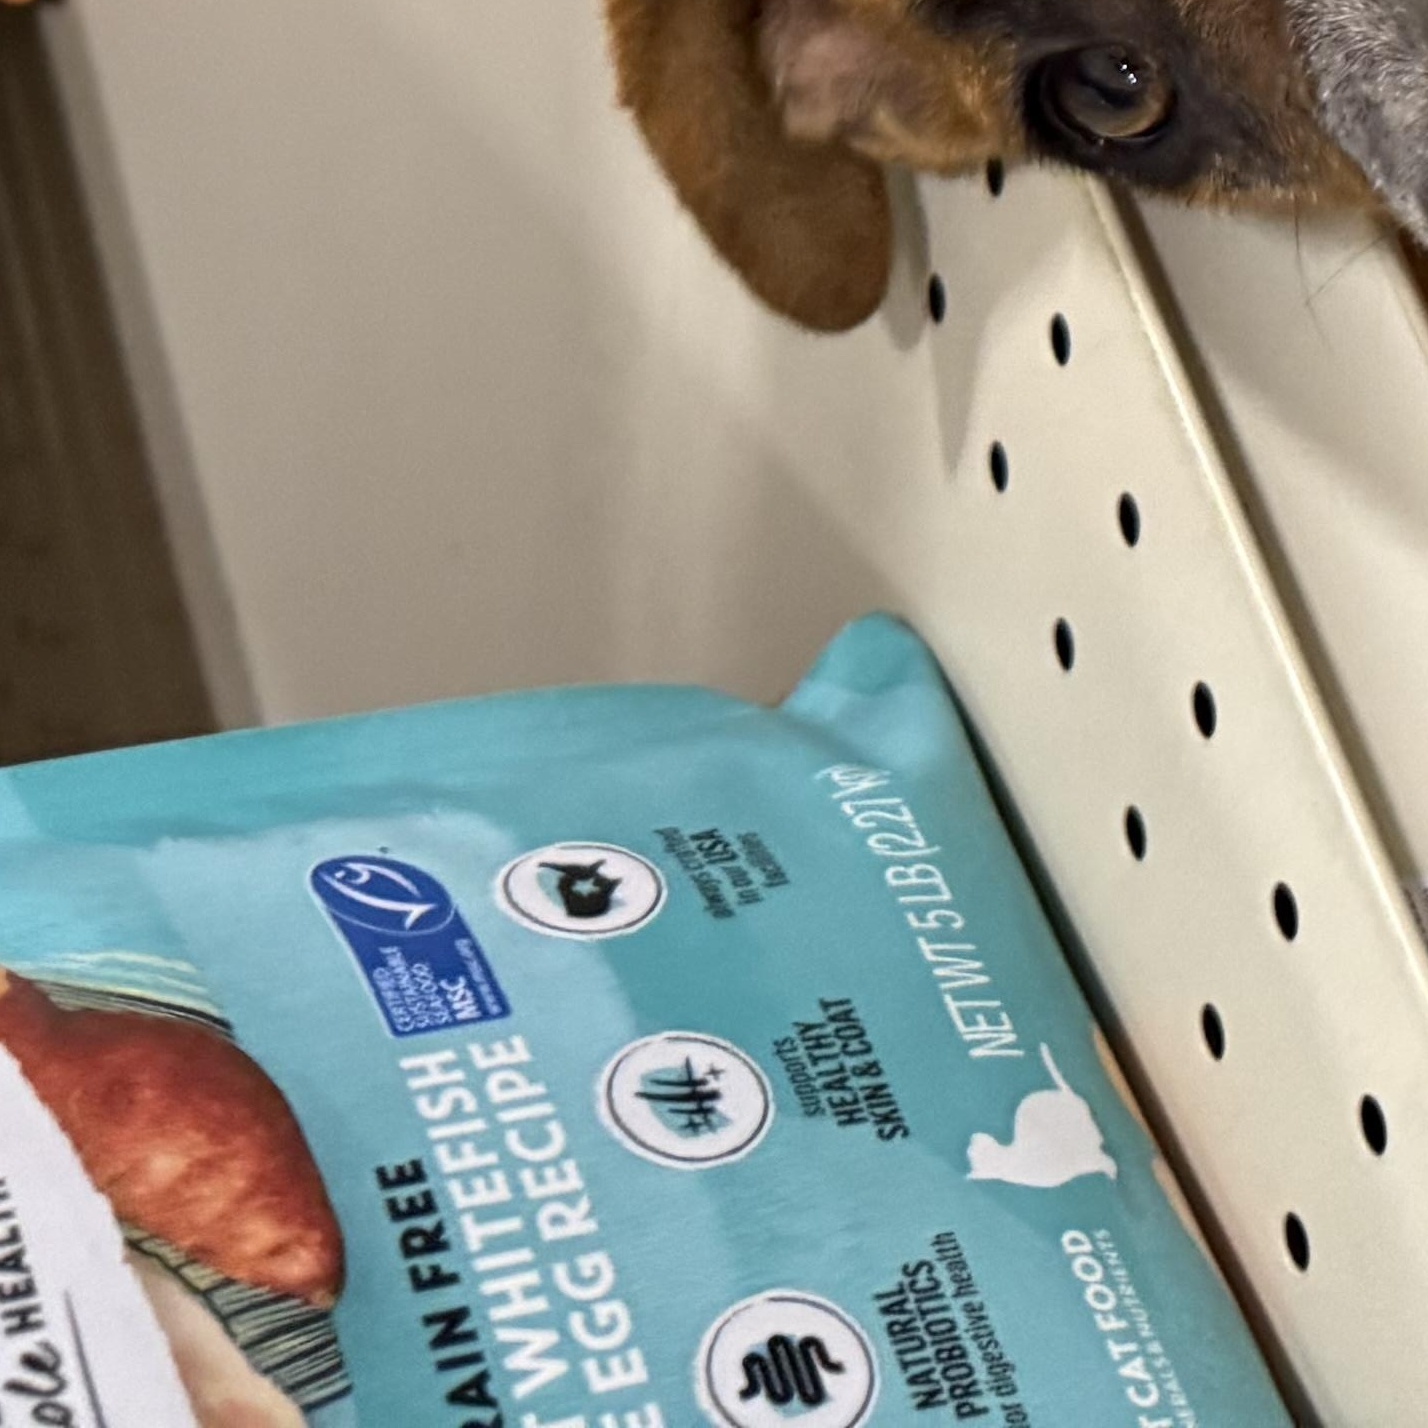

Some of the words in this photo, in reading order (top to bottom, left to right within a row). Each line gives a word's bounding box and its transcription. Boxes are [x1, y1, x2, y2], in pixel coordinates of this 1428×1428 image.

[688, 827, 737, 865] USA
[882, 862, 953, 908] LB
[905, 907, 966, 935] 5
[371, 966, 414, 1034] CERTIFIED
[378, 945, 430, 1029] SUSTAINABLE
[412, 963, 453, 1024] SEAFOOD
[439, 975, 481, 1020] MSC
[915, 937, 991, 994] WT
[818, 996, 873, 1059] COAT
[941, 994, 1026, 1058] NET
[772, 1036, 824, 1118] supports
[792, 1018, 868, 1127] HEALTHY
[848, 1060, 883, 1082] &
[471, 1035, 600, 1244] RECIPE
[859, 1081, 910, 1143] SKIN
[0, 1176, 45, 1336] HEAL
[373, 1157, 460, 1294] FREE
[400, 1049, 570, 1398] WHITEFISH
[929, 1230, 980, 1298] health
[1060, 1229, 1129, 1331] FOOD
[552, 1251, 648, 1394] EGG
[874, 1286, 947, 1411] NATURAL
[902, 1259, 988, 1420] PROBIOTICS
[955, 1300, 1018, 1399] digestive
[0, 1341, 74, 1428] ole
[1106, 1339, 1161, 1408] CAT
